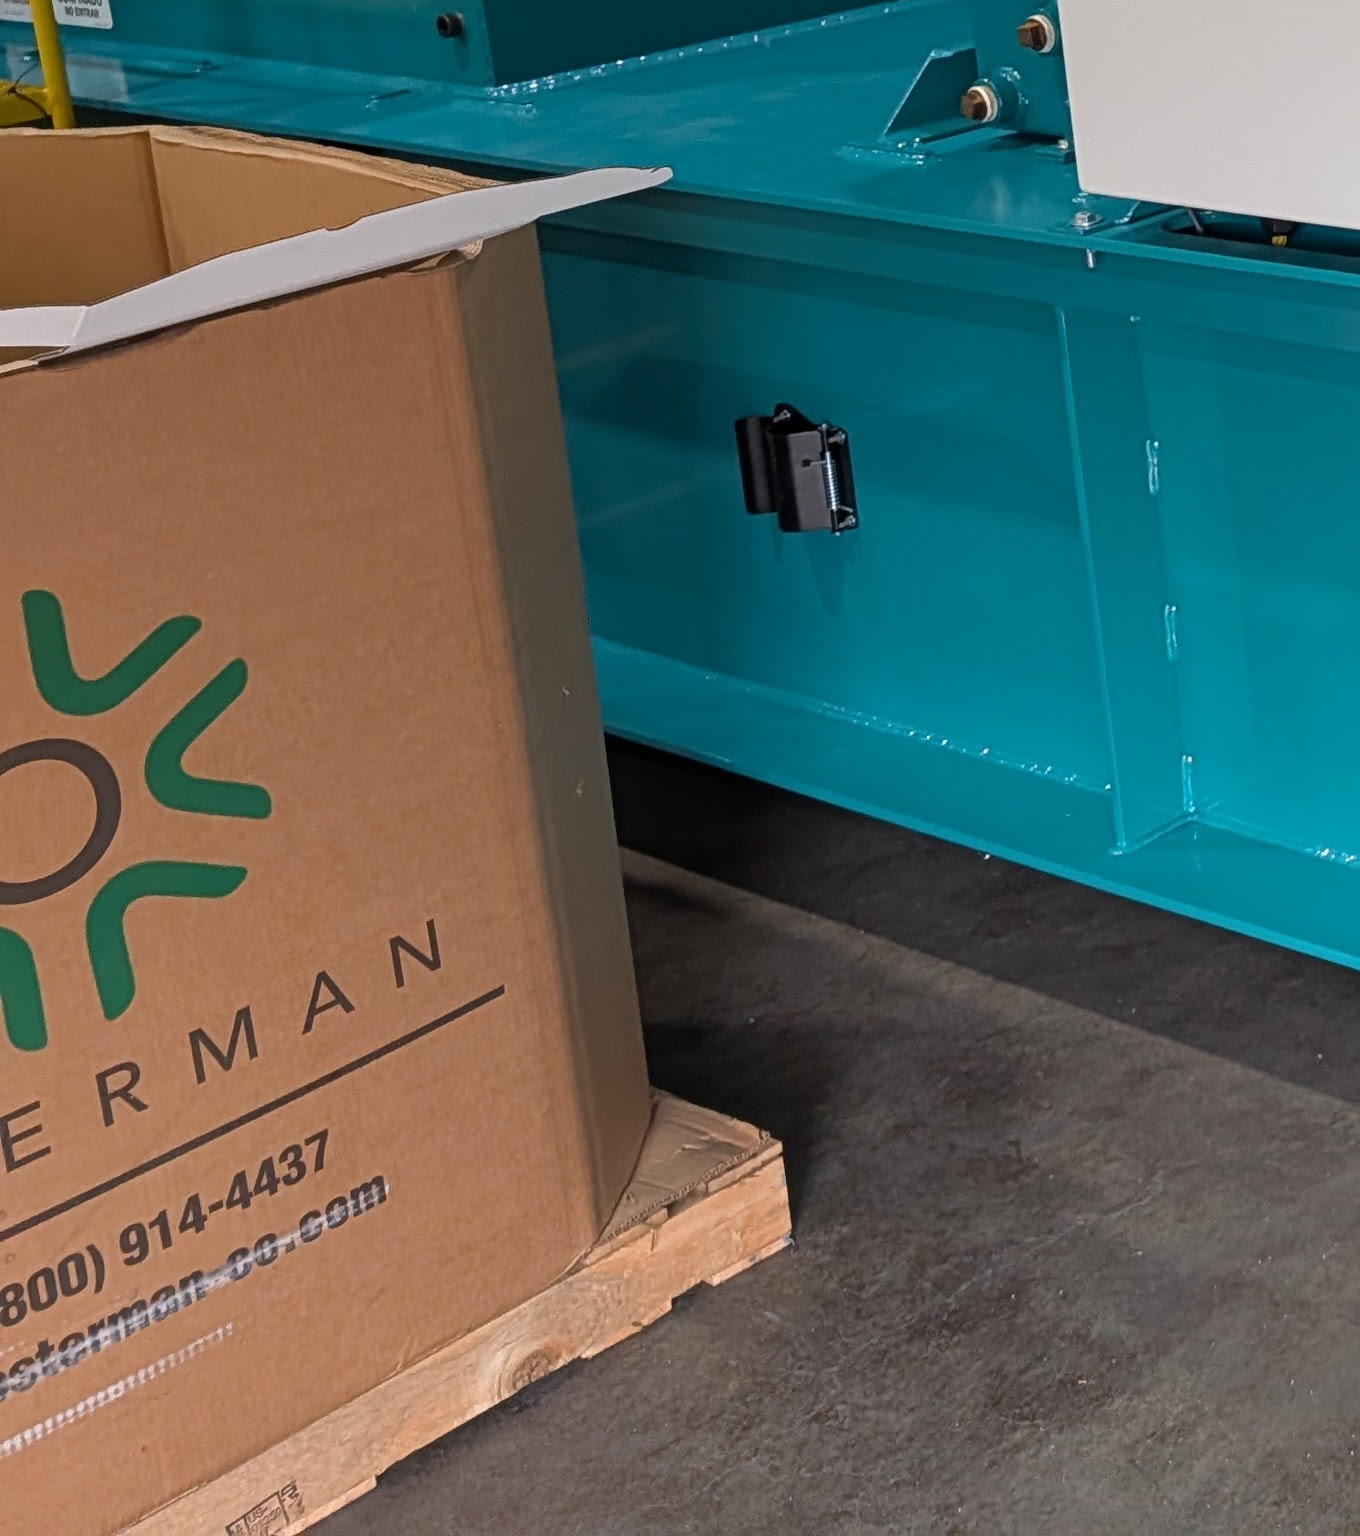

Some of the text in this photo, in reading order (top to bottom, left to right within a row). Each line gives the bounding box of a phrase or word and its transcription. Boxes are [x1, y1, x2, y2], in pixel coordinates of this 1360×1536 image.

[1, 919, 442, 1173] ERMAN
[0, 1128, 331, 1328] 800) 914-4437
[0, 1175, 389, 1404] sterman-co.com
